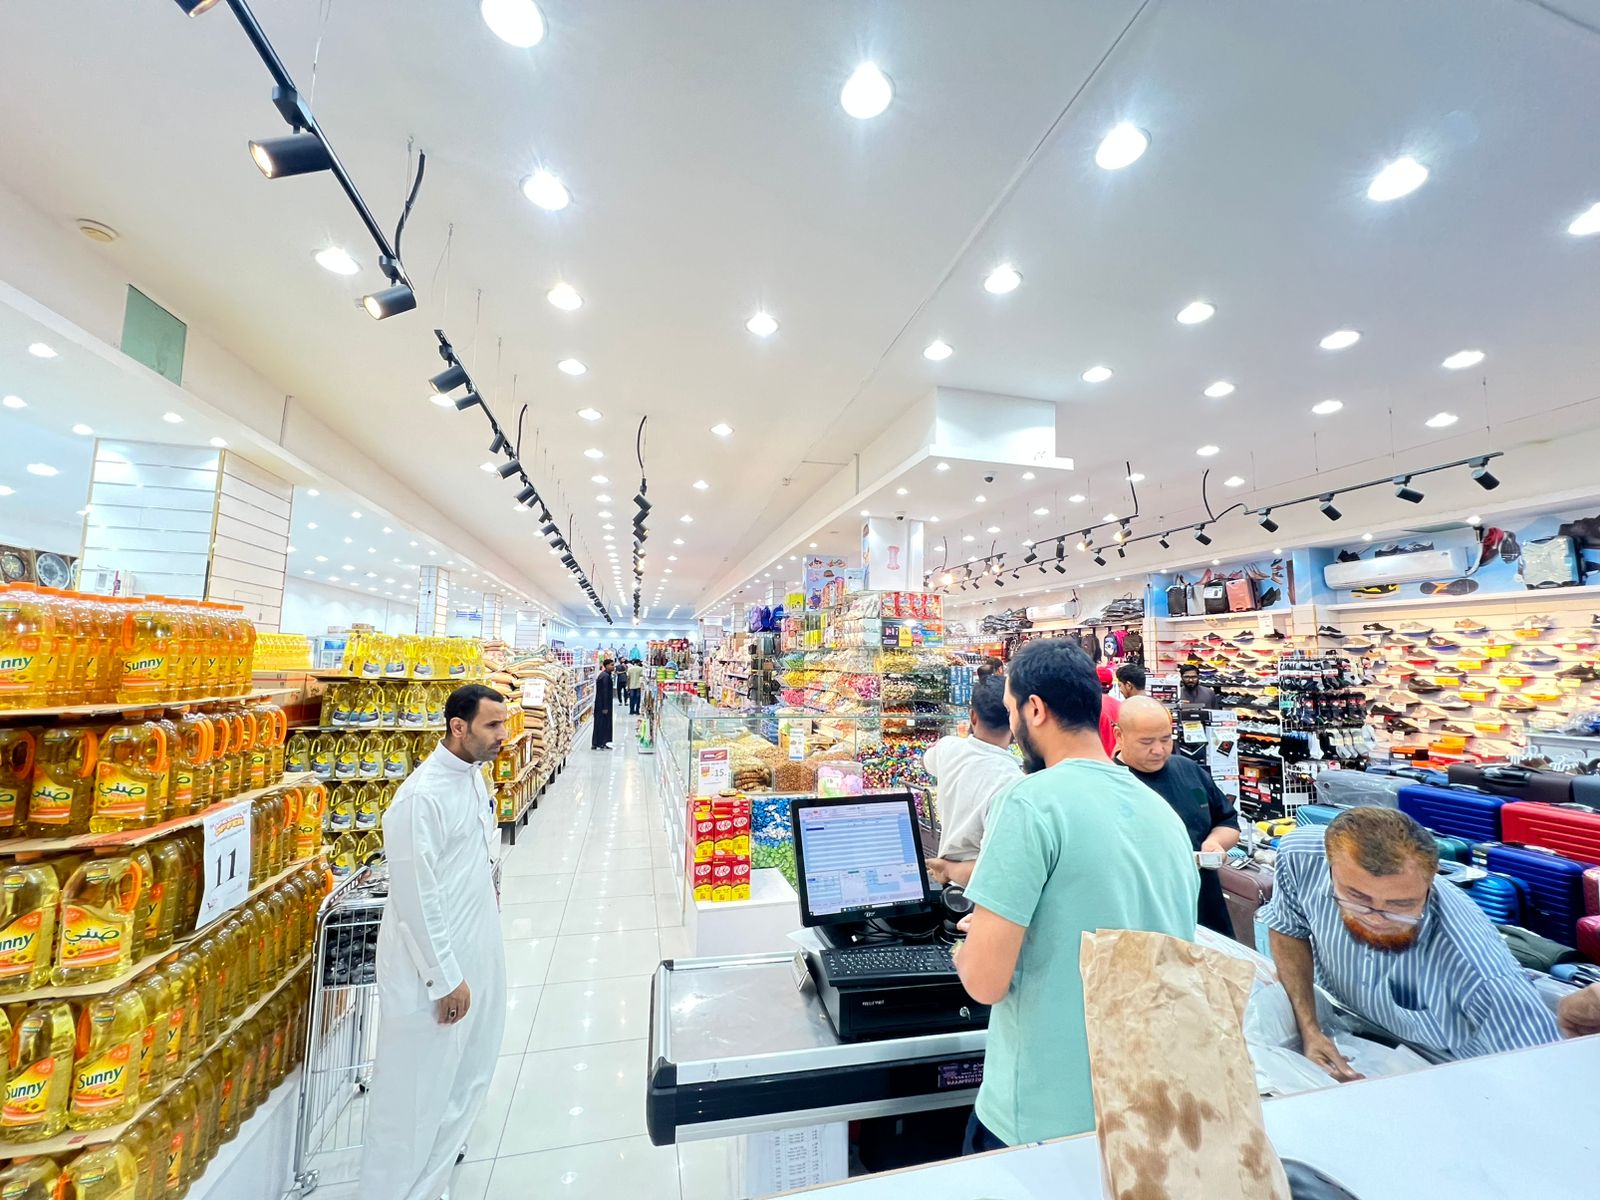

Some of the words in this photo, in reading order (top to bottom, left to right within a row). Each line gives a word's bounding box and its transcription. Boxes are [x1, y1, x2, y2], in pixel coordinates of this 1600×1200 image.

[1, 656, 33, 671] nny
[124, 656, 165, 674] Sunny
[215, 848, 237, 889] 11
[78, 1064, 124, 1089] Sunny
[5, 1080, 47, 1100] Sunny
